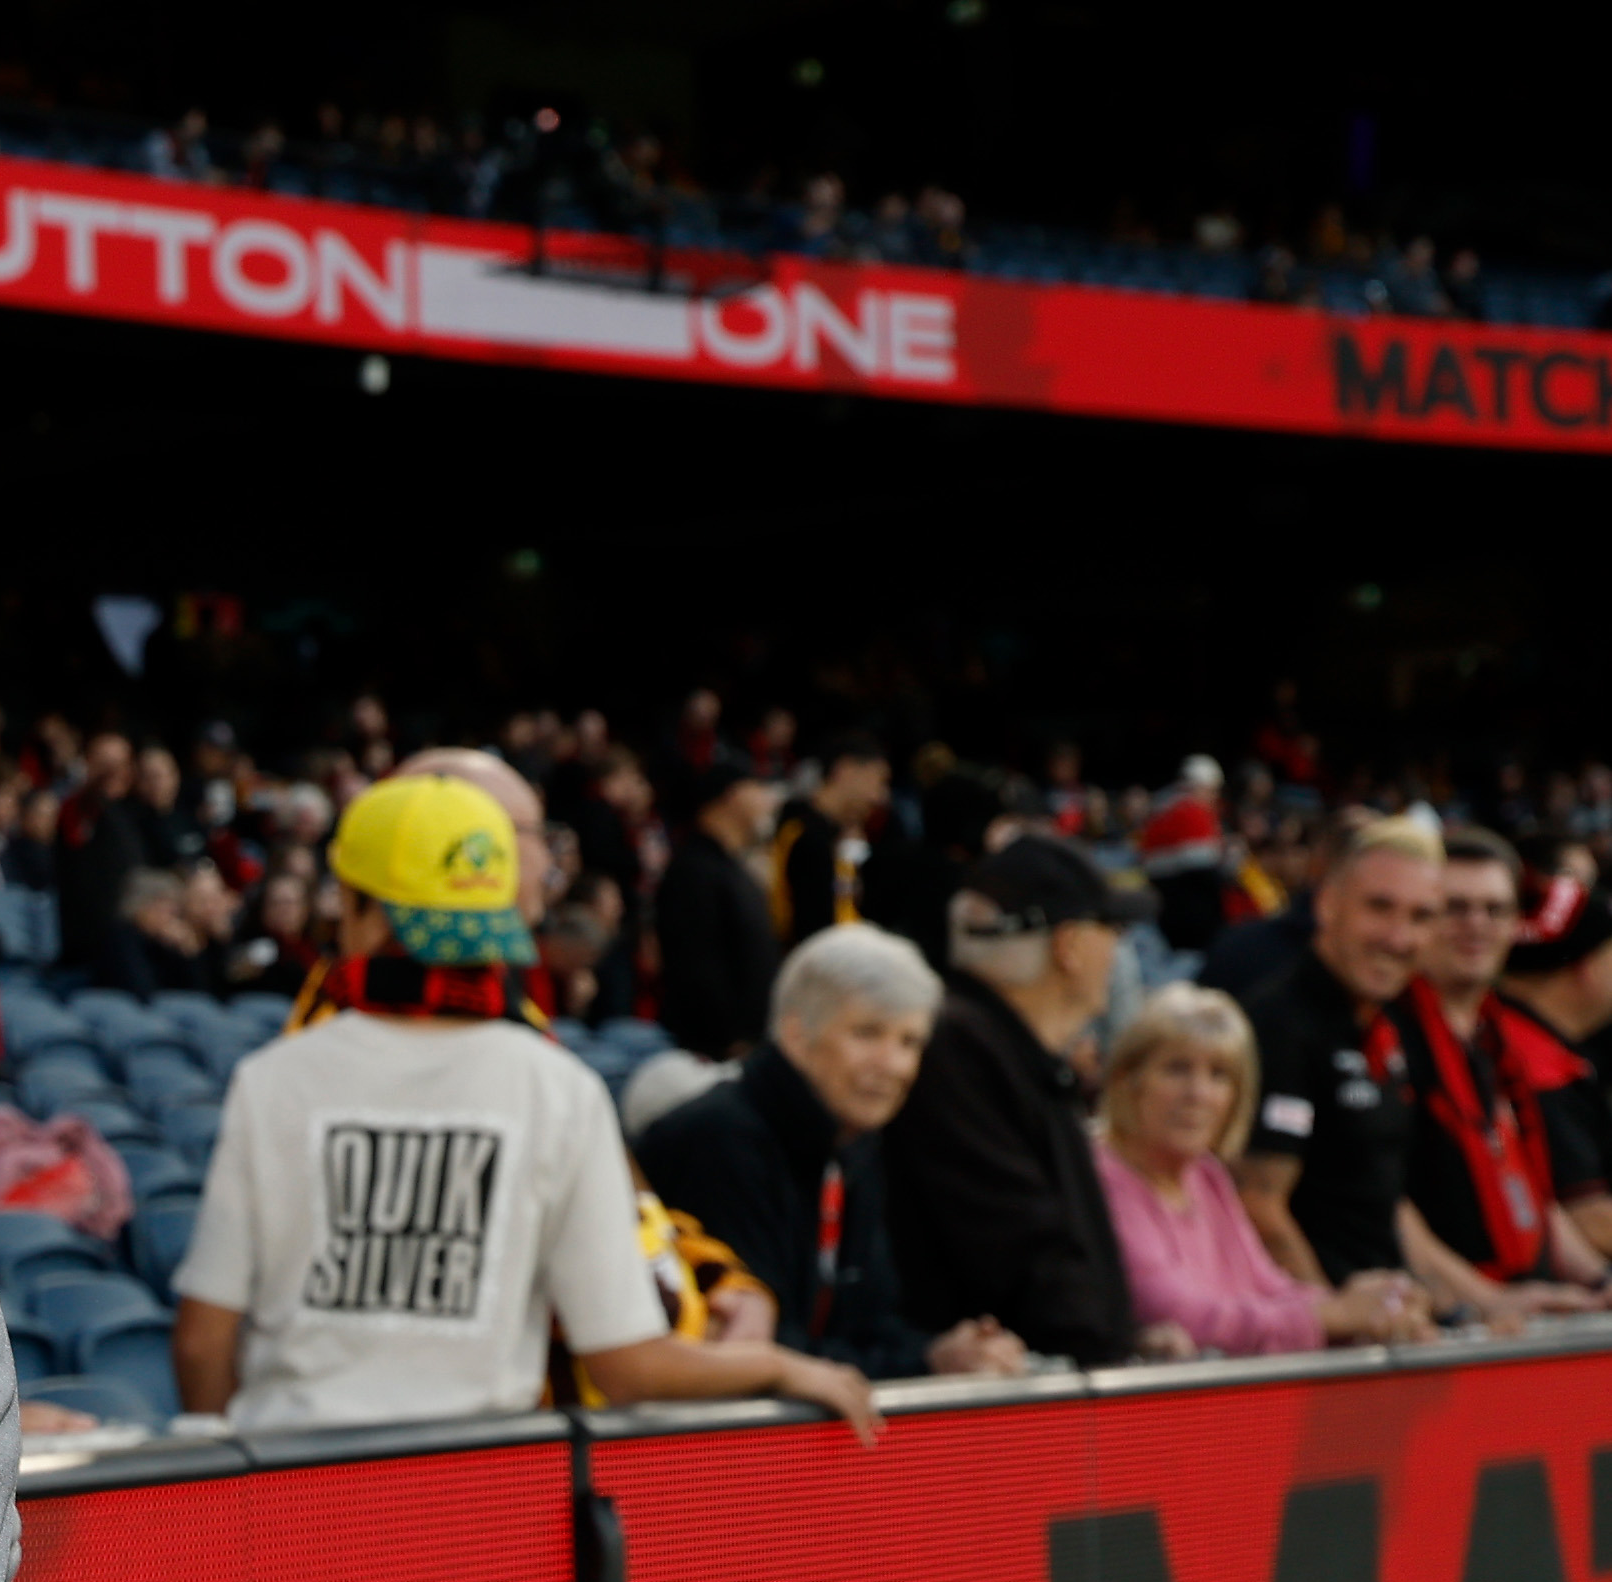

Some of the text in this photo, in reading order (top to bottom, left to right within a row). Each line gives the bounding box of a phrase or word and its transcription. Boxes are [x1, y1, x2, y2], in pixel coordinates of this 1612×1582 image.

[699, 280, 958, 383] ONE
[326, 1125, 502, 1235] QUIK
[304, 1236, 481, 1316] SILVER
